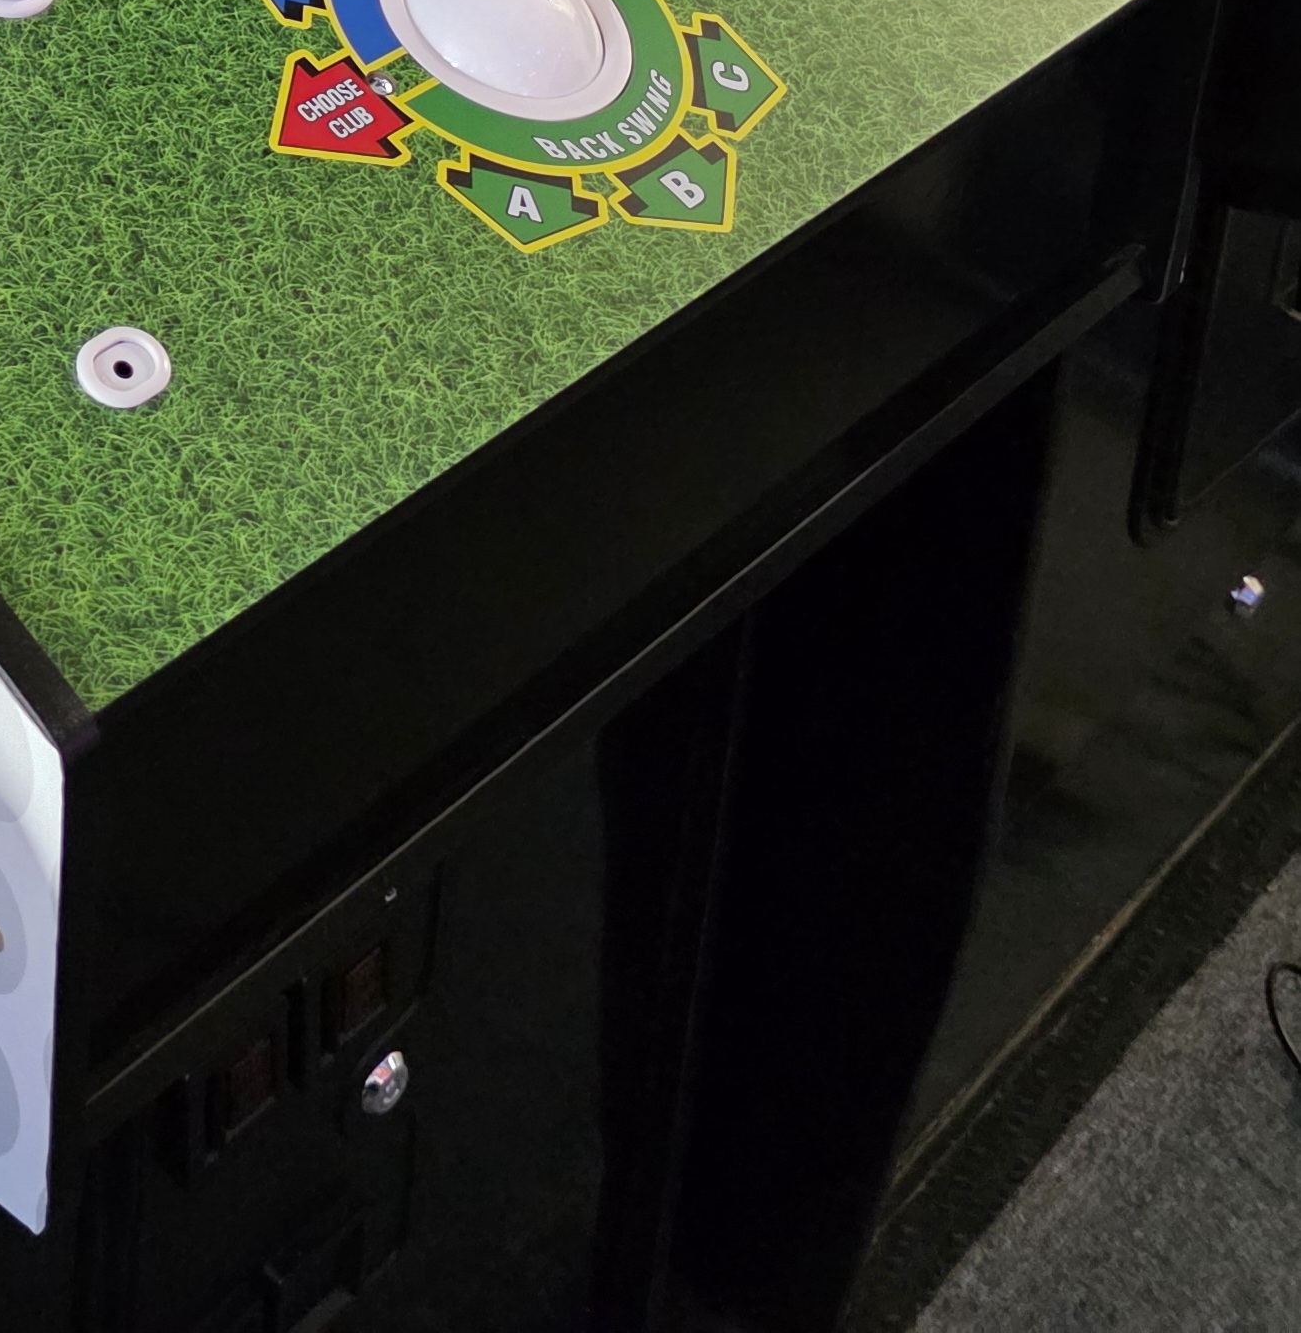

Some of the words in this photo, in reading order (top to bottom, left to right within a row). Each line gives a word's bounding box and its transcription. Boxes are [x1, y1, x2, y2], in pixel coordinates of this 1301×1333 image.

[713, 61, 752, 92] C
[297, 78, 365, 124] CHOOSE
[535, 132, 622, 161] BACK
[618, 67, 674, 146] SWING
[328, 107, 376, 139] CLUB
[507, 187, 542, 224] A
[660, 172, 706, 210] B
